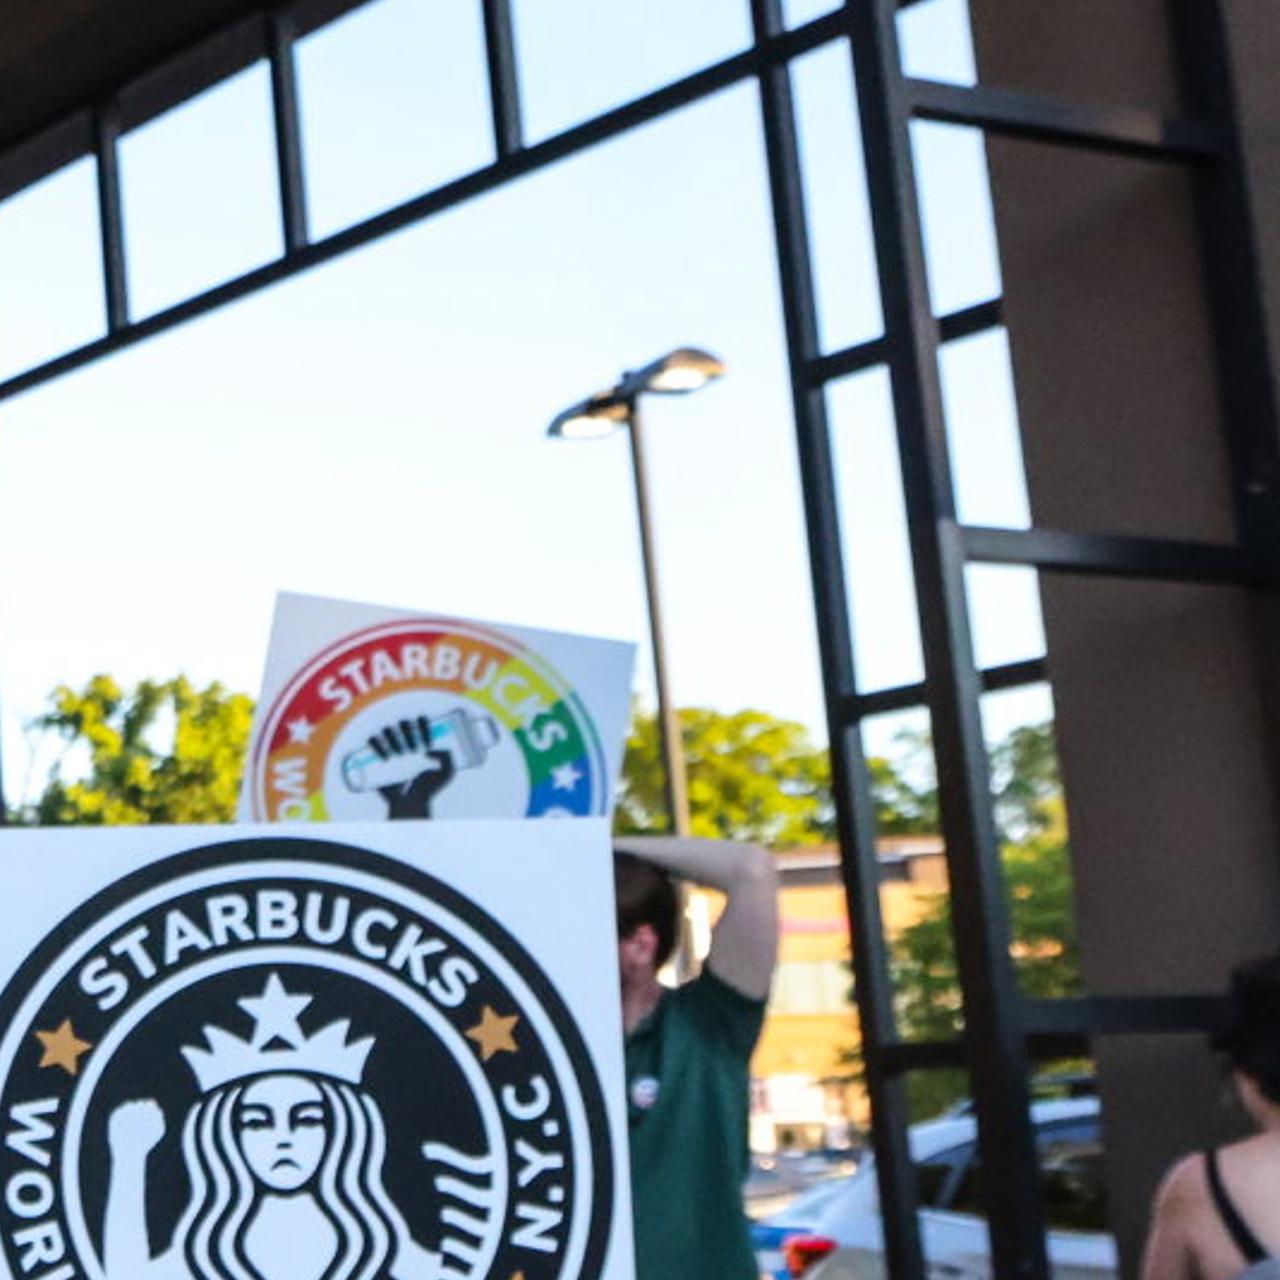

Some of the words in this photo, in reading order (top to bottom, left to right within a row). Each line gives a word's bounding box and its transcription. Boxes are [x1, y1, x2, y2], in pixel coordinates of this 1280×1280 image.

[318, 643, 567, 752] STARBUCKS
[78, 889, 480, 1011] STARBUCKS
[502, 1074, 565, 1254] N.Y.C
